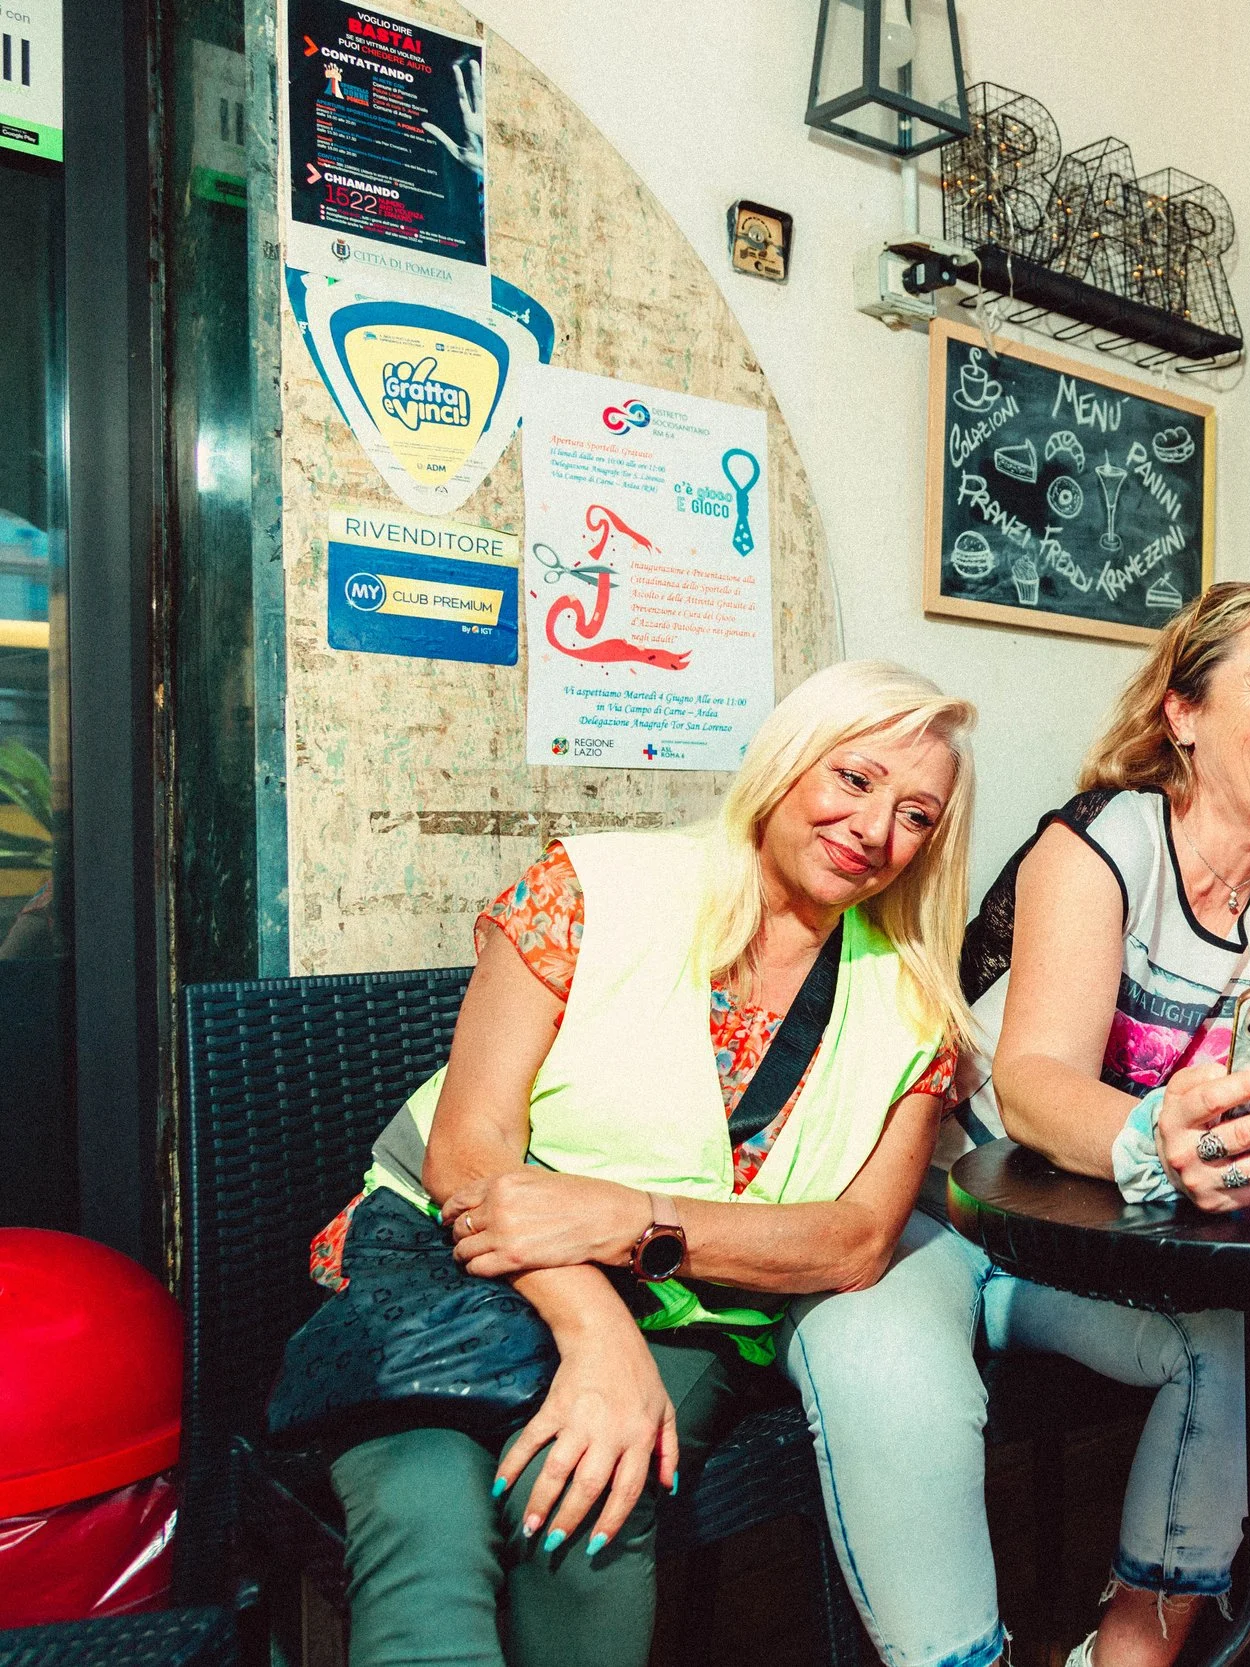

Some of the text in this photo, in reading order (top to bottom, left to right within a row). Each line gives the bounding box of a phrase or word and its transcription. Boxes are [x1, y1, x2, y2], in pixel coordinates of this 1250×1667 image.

[6, 10, 30, 24] con
[358, 12, 412, 37] VOGLIO DIRE
[348, 17, 422, 54] BASTA!
[321, 47, 414, 83] CONTATTANDO
[338, 38, 432, 74] PUOI CHIEDERE AIUTO
[397, 48, 425, 63] VIOLENZA
[324, 173, 400, 199] CHIAMANDO
[324, 184, 377, 215] 1522
[940, 82, 1243, 342] BAR
[353, 250, 452, 281] CITTÀ DI POMEZIA
[386, 376, 459, 406] Gratta
[948, 395, 1020, 468] COLAZIONI
[426, 463, 447, 472] ADM
[1126, 441, 1182, 521] PANINI
[691, 498, 729, 518] GIOCO
[346, 517, 504, 557] RIVENDITORE
[957, 470, 1094, 593] PRANZI FREDDI
[1096, 525, 1186, 602] TRAMEZZINI
[351, 582, 493, 613] MY CLUB PREMIUM
[461, 625, 492, 635] By IGT
[563, 685, 574, 695] Vi
[576, 687, 621, 701] aspettiamo
[623, 689, 656, 700] Martedì
[665, 693, 693, 705] Giugno
[694, 694, 710, 704] Alle
[726, 697, 746, 706] 11:00
[596, 702, 717, 718] in Via Campo di Carne Ardea
[578, 714, 732, 732] Delegazione Anagrafe Tor San Lorenzo
[573, 738, 614, 747] REGIONE
[574, 747, 602, 756] LAZIO
[1150, 998, 1206, 1028] LIGHT
